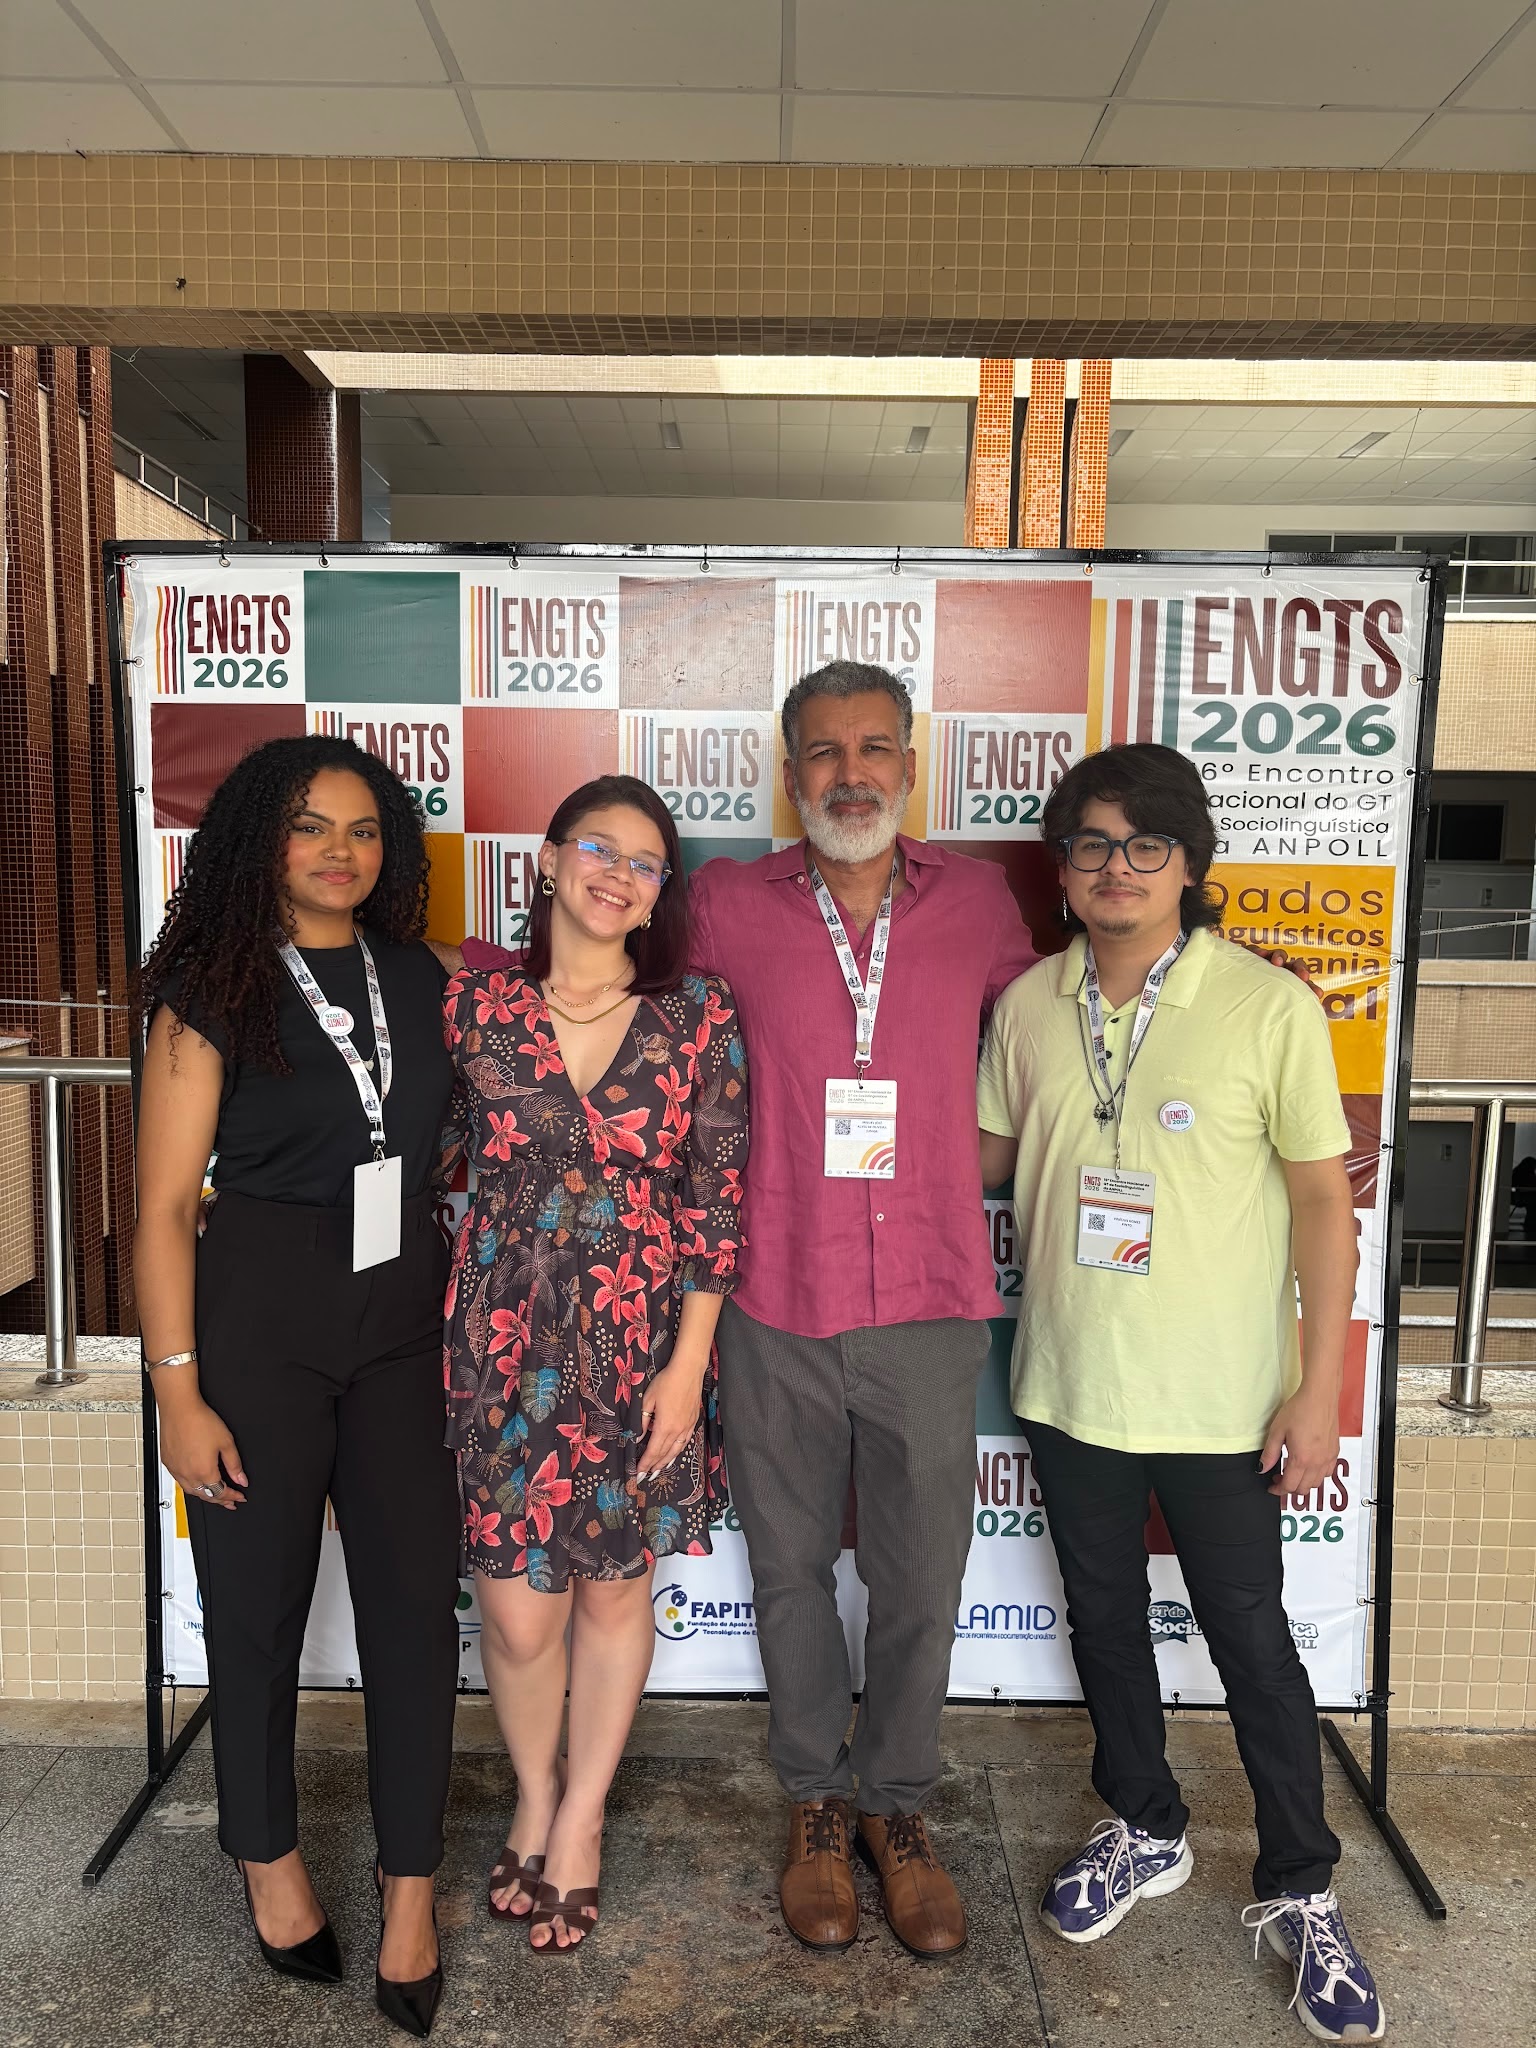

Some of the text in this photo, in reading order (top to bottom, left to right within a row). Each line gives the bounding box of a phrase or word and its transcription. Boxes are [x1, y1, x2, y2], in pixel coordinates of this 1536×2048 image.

[187, 595, 291, 654] ENGTS
[502, 597, 606, 658] ENGTS
[817, 601, 921, 662] ENGTS
[1192, 596, 1403, 699] ENGTS
[193, 658, 289, 689] 2026
[508, 662, 603, 694] 2026
[1192, 701, 1396, 756] 2026
[657, 728, 759, 788] ENGTS
[966, 731, 1072, 791] ENGTS
[1193, 762, 1395, 785] 6º Encontro
[662, 791, 756, 821] 2026
[970, 794, 1041, 824] 202
[1208, 790, 1392, 811] acional do GT
[1220, 816, 1389, 837] Sociolinguística
[1214, 837, 1388, 857] a ANPOLL
[1209, 921, 1385, 947] nguísticos
[1142, 988, 1153, 1007] ENGTS
[1323, 986, 1378, 1020] al
[327, 1018, 345, 1028] ENGTS
[829, 1089, 846, 1099] ENGTS
[1170, 1110, 1188, 1120] ENGTS
[1084, 1175, 1101, 1187] ENGTS
[977, 1510, 1044, 1538] 026
[1281, 1514, 1344, 1543] 026
[691, 1602, 754, 1618] FAPIT
[954, 1604, 1056, 1631] LAMID
[1148, 1605, 1186, 1618] GT de
[1149, 1617, 1203, 1635] Socio
